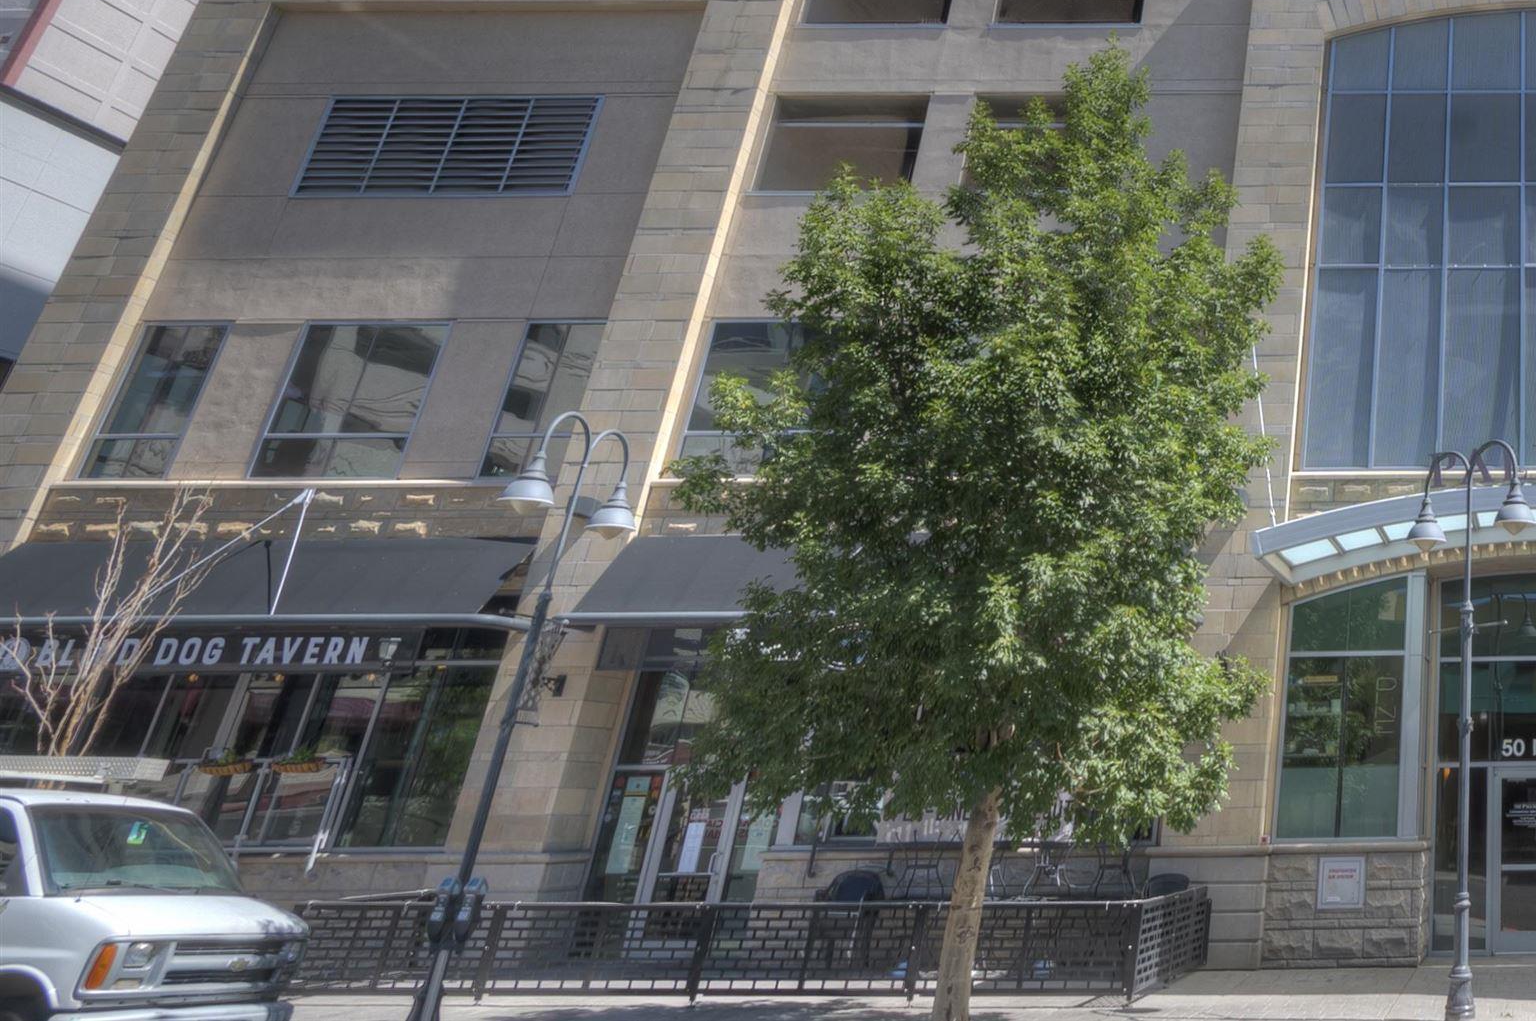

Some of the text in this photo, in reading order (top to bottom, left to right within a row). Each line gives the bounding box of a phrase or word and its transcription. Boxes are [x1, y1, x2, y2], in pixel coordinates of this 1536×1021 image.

[34, 637, 370, 667] BLD DOG TAVERN
[1501, 738, 1526, 757] 50
